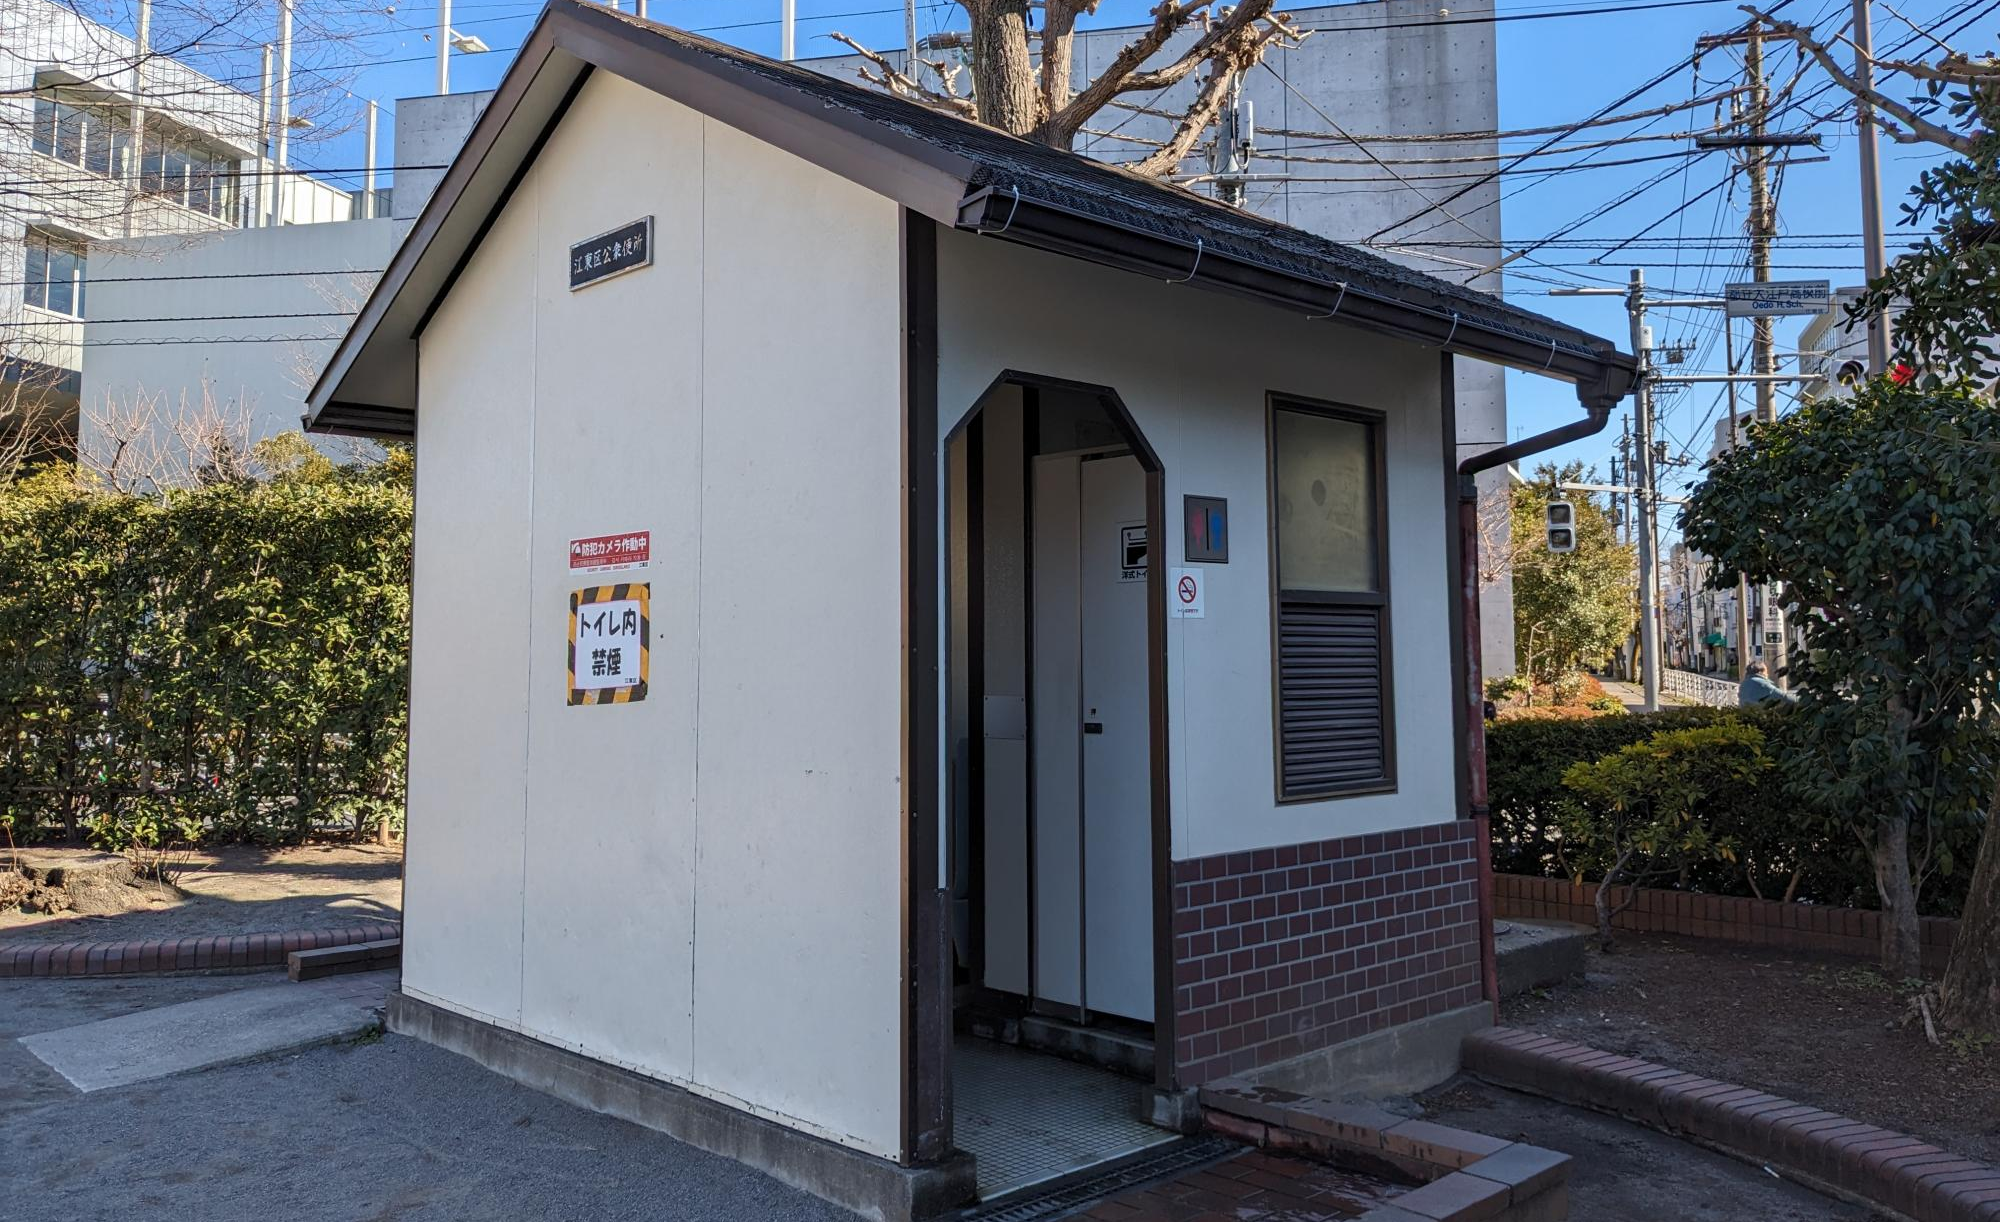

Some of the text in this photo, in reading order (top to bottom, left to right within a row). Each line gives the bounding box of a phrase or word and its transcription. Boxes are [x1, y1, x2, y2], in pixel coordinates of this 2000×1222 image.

[574, 233, 643, 275] 江東区公衆便所
[1752, 301, 1774, 309] Oedo
[581, 536, 647, 557] 防犯カメラ作動中
[580, 608, 637, 638] トイレ内
[591, 647, 622, 676] 禁煙
